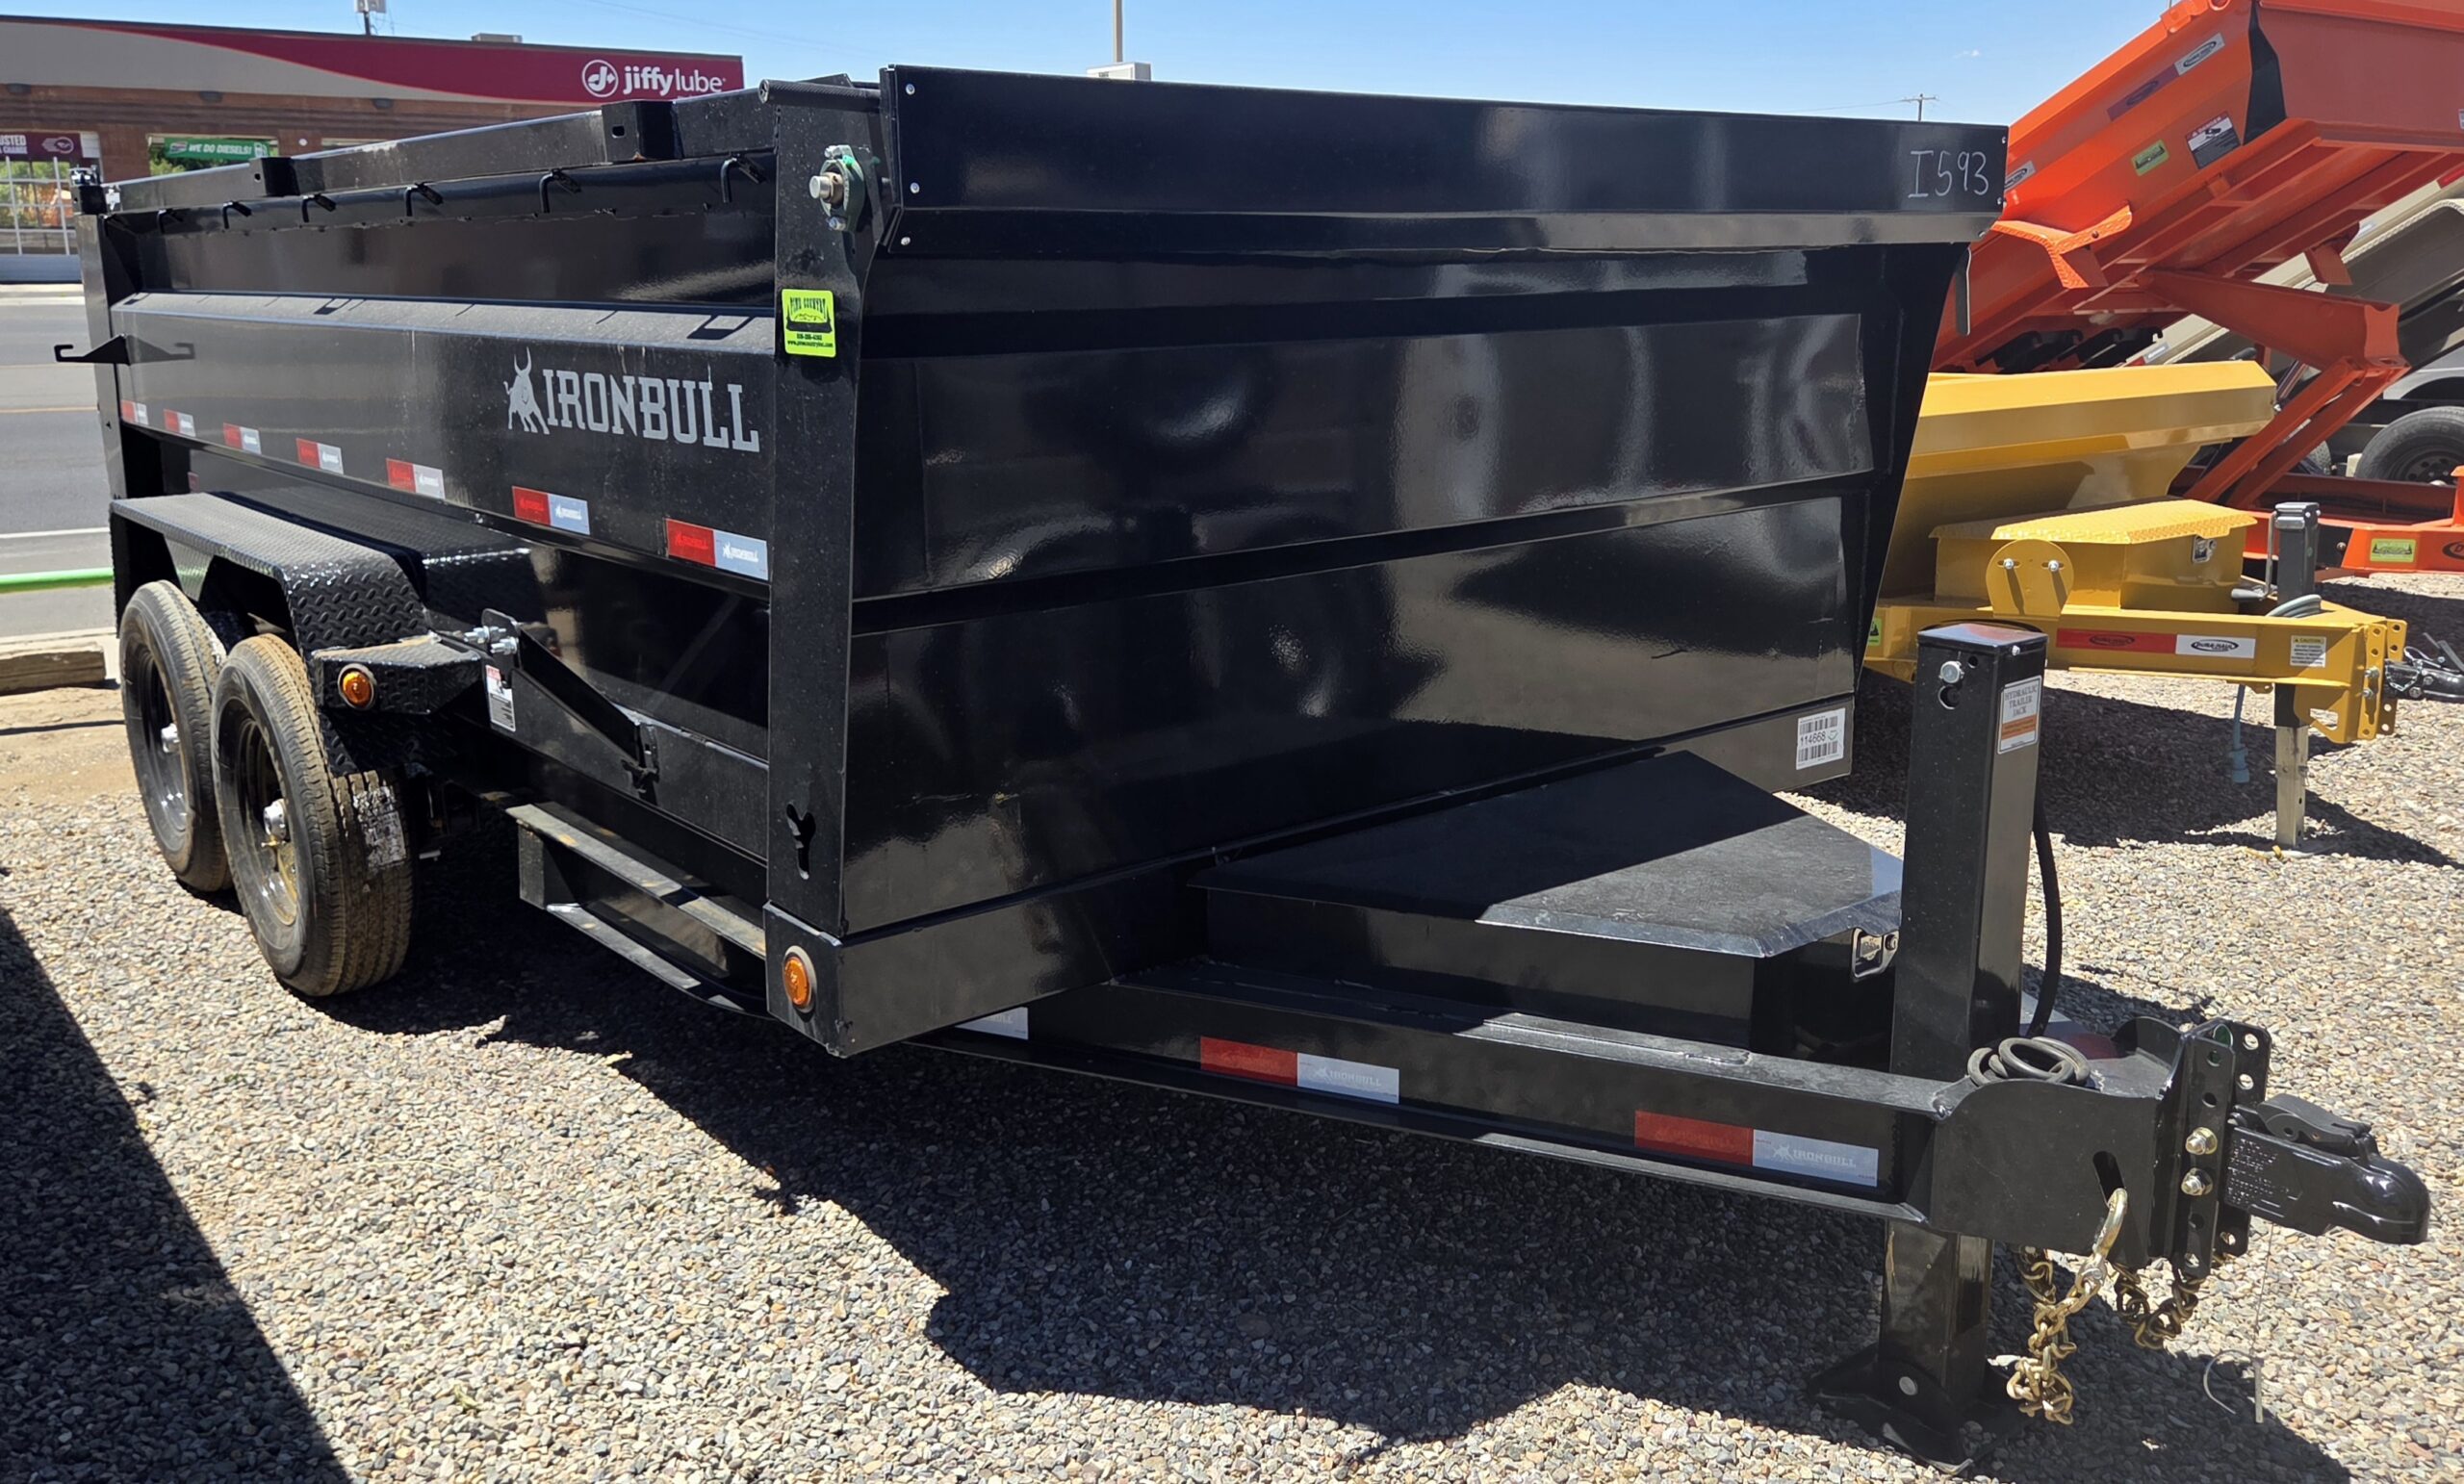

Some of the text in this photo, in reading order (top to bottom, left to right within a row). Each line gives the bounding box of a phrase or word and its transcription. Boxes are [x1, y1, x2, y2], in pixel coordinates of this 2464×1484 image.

[623, 65, 722, 96] jiffy lube
[189, 143, 252, 154] WE DO DIESELS!
[1908, 150, 1989, 198] I593
[543, 369, 760, 452] IRONBULL
[1800, 730, 1827, 747] 114668
